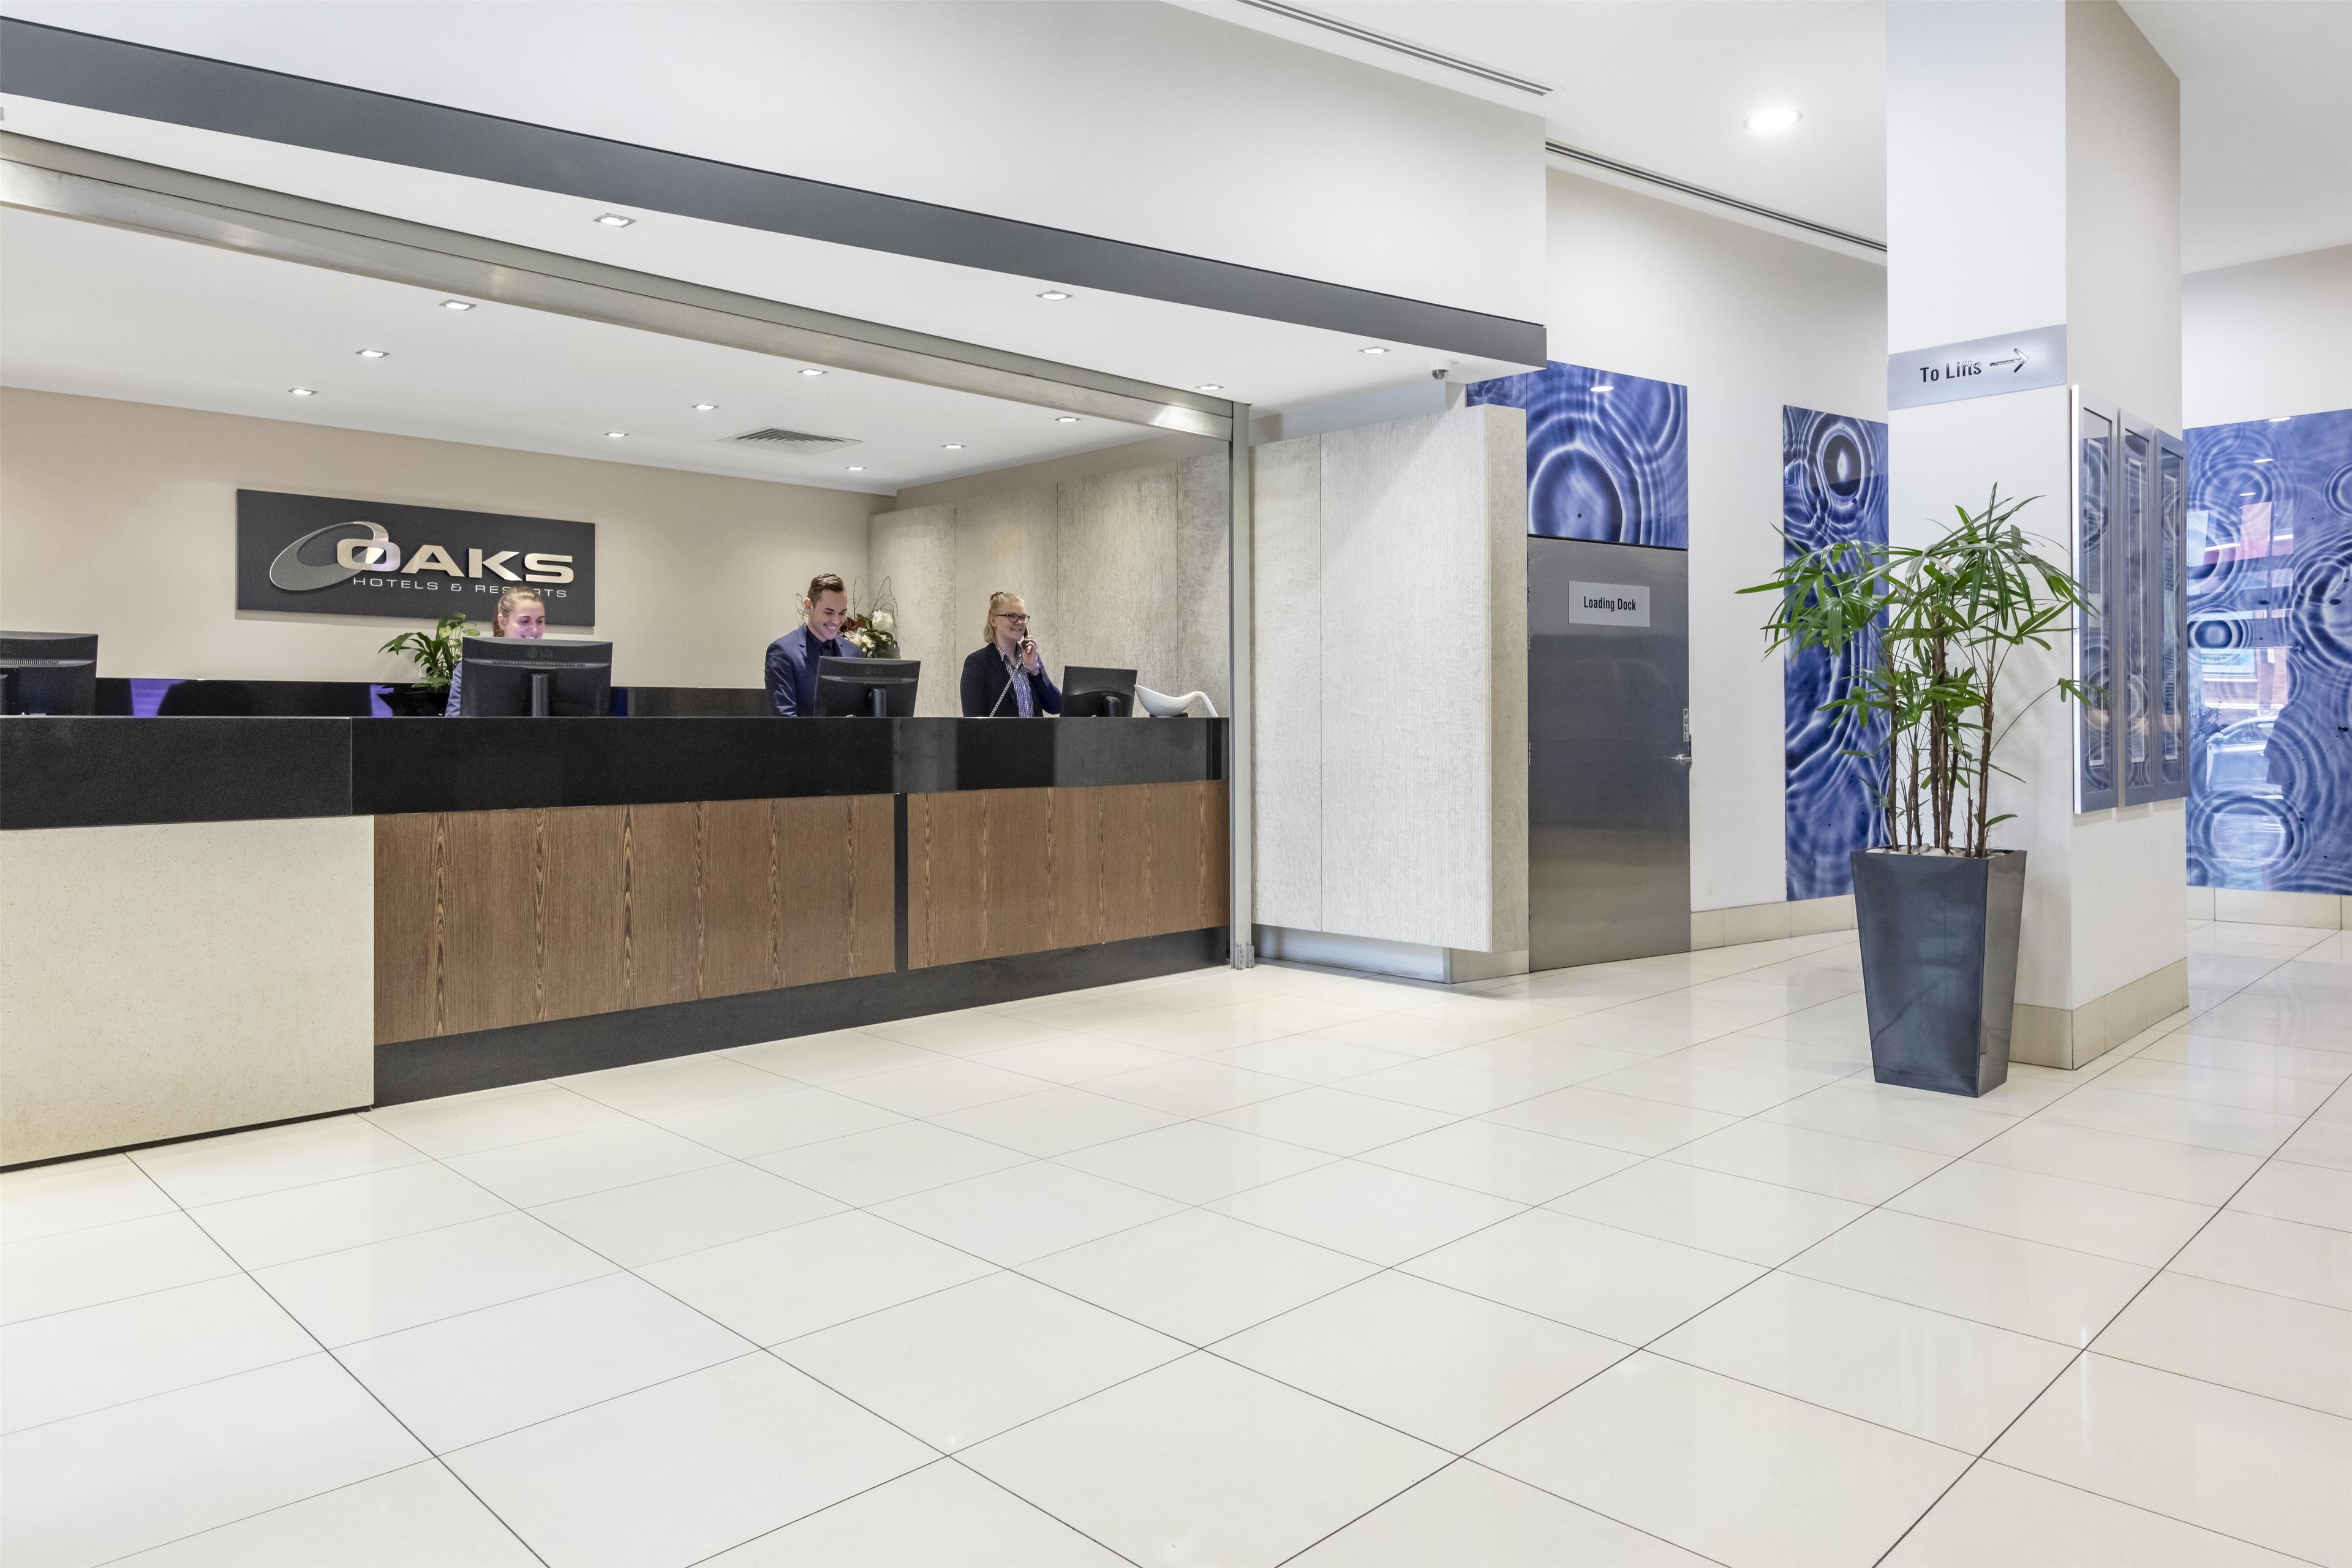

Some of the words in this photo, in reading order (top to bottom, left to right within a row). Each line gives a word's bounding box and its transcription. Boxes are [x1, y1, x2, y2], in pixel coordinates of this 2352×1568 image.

[1920, 367, 1939, 382] To
[1946, 360, 1981, 379] Lifts
[337, 538, 574, 584] OAKS
[353, 578, 438, 590] HOTELS
[475, 585, 567, 598] RESRTS
[1584, 596, 1614, 612] Loading
[1618, 598, 1636, 611] Dock
